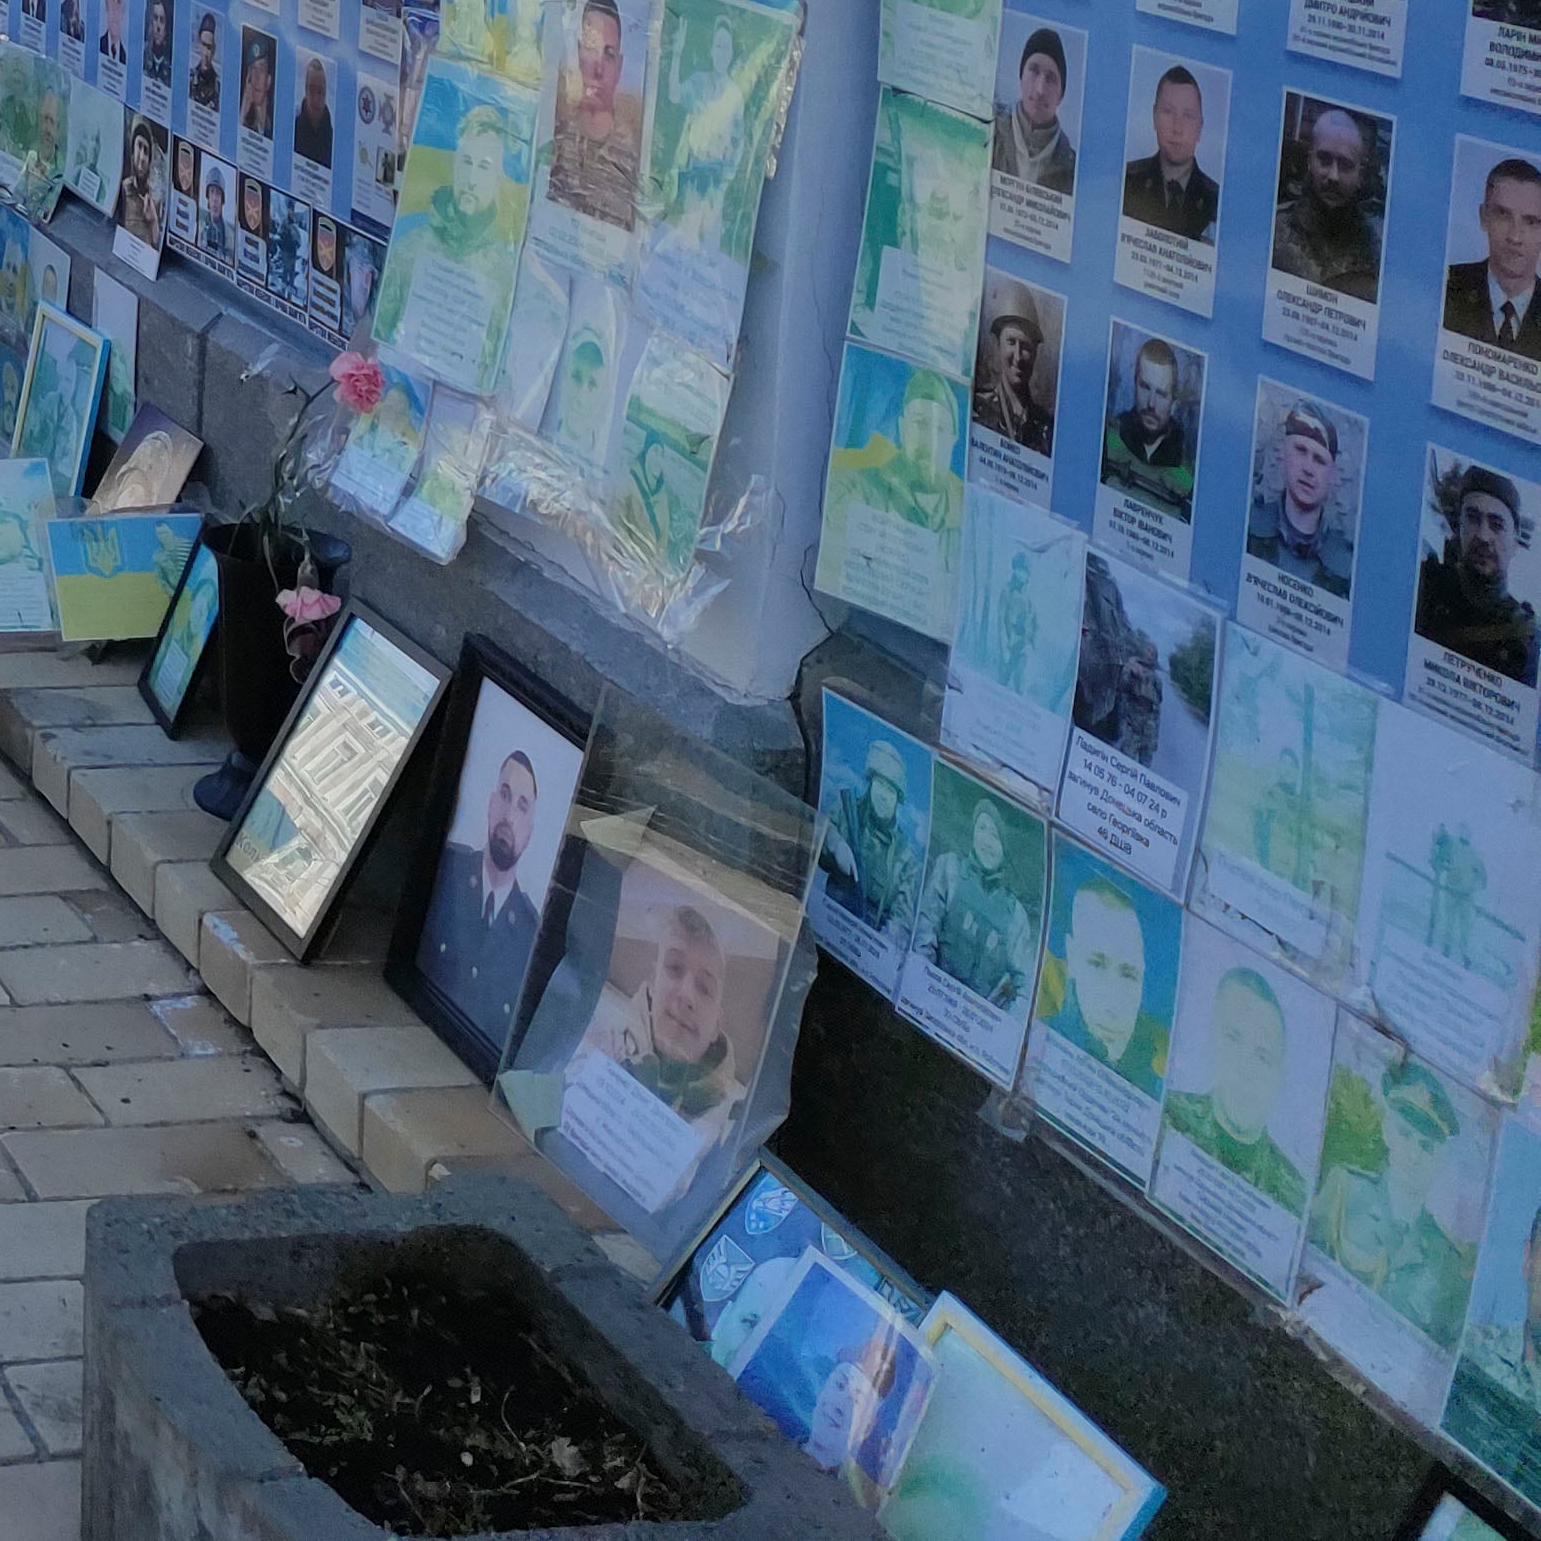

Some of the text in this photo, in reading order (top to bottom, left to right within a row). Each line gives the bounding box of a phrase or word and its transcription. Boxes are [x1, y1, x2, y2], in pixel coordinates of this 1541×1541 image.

[1338, 3, 1391, 27] АНДРІЙОВИЧ
[1276, 288, 1365, 331] ОЛЕКСАНДР ПЕТРОВИЧ
[1306, 284, 1338, 304] ШИМОН
[1442, 349, 1495, 379] ОЛЕКСАНДР
[1467, 340, 1538, 375] ПОНОМАРЕНКО
[1113, 506, 1172, 545] ВІКТОР ІВАНОВИЧ
[1123, 497, 1163, 525] ЛАВРЕНЧУК
[1277, 572, 1313, 598] НОСЕНКО
[1289, 590, 1343, 629] ОЛЕКСІЙОВИЧ
[1423, 658, 1519, 713] МИКОЛА ВІКТОРОВИЧ
[1442, 651, 1502, 688] ПЕТРУЧЕНКО
[1083, 758, 1092, 771] 14
[1094, 765, 1105, 779] 05
[1106, 772, 1117, 786] 76
[1124, 784, 1135, 798] 04
[1137, 791, 1148, 804] 07
[1149, 799, 1160, 813] 24
[1110, 756, 1139, 780] Сергій
[1139, 773, 1181, 807] Павлович
[1067, 771, 1178, 846] загинув Донецька область
[1087, 802, 1107, 820] село
